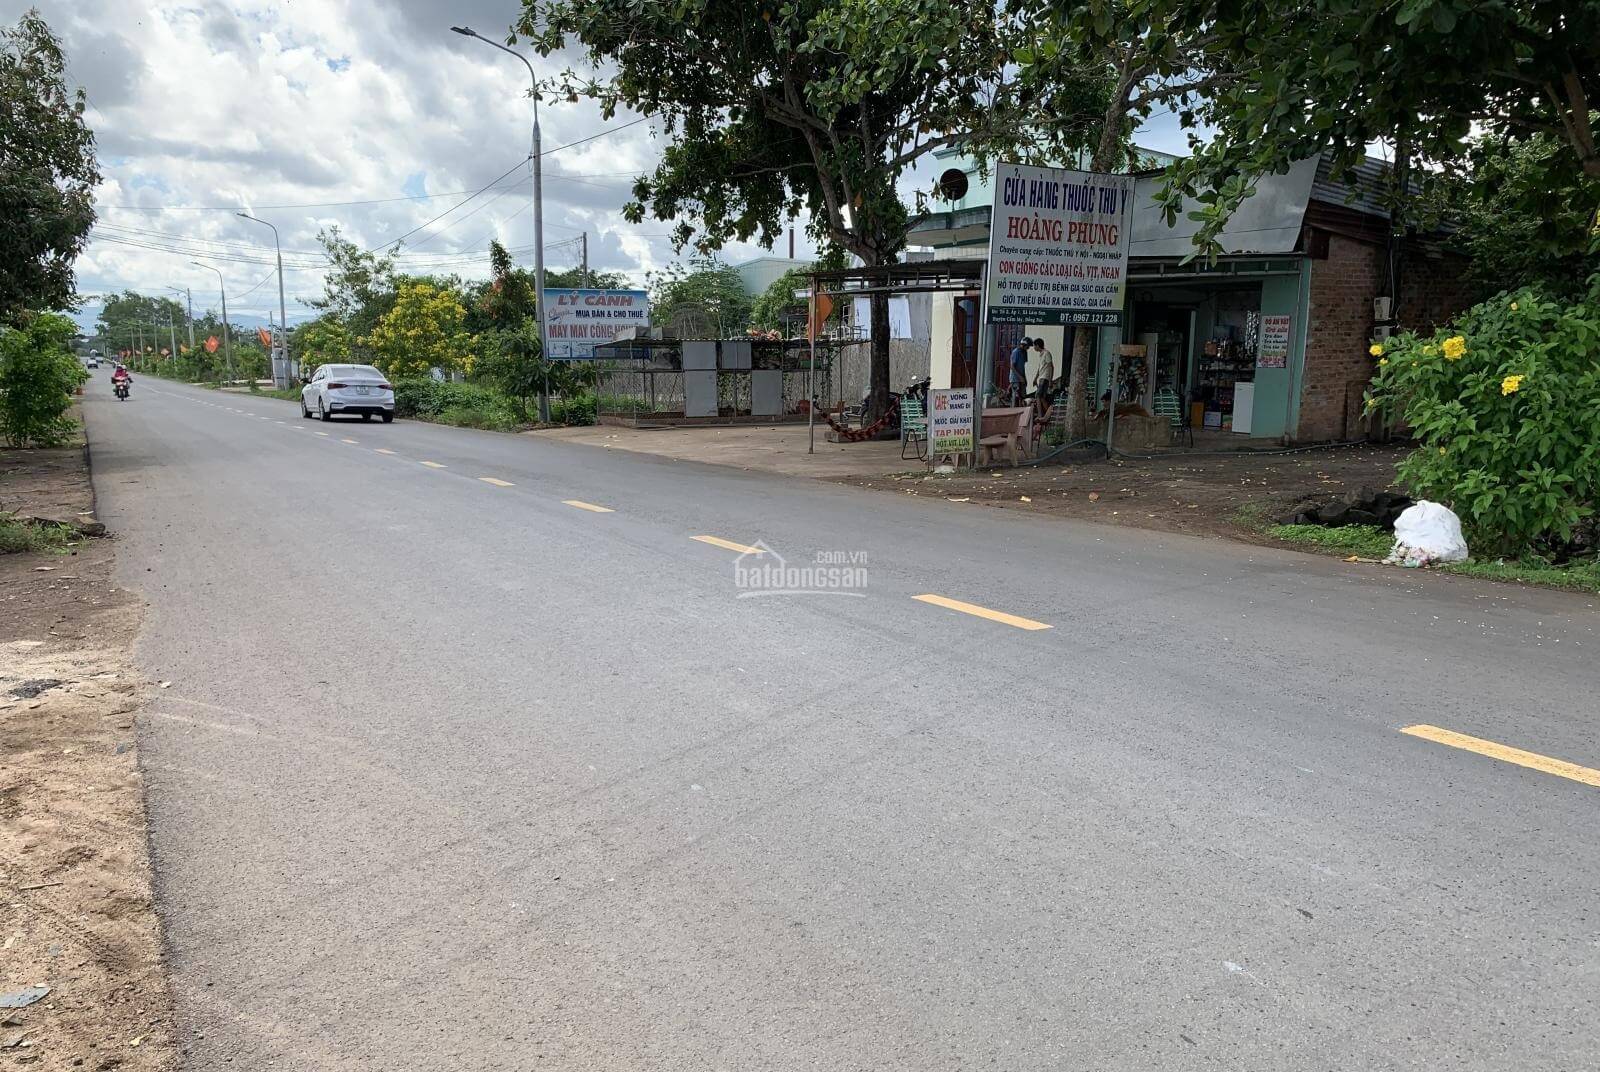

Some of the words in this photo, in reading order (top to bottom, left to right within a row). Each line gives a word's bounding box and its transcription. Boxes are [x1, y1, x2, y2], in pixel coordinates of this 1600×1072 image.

[1004, 168, 1026, 207] CỬA
[1029, 174, 1059, 210] HÀNG
[1062, 177, 1096, 213] THUỐC
[1120, 189, 1128, 215] Y
[1007, 212, 1063, 242] HOÀNG
[1067, 221, 1119, 249] PHỤNG
[999, 245, 1018, 255] Chuyên
[1019, 248, 1032, 256] cung
[1045, 247, 1063, 256] THUỐC
[999, 260, 1015, 274] CON
[1016, 256, 1039, 275] GIỐNG
[1040, 260, 1055, 276] CÁC
[1055, 263, 1073, 279] LOẠI
[1101, 266, 1120, 279] NGAN
[1009, 280, 1022, 291] TRỢ
[1040, 282, 1051, 292] TRỊ
[1070, 284, 1080, 293] GIA
[1081, 283, 1094, 293] SÚC
[1094, 285, 1105, 294] GIA
[585, 291, 634, 306] CẢNH
[1052, 297, 1060, 306] RA
[1061, 298, 1072, 306] GIA
[1088, 298, 1098, 307] GIA
[576, 310, 590, 318] MUA
[1073, 313, 1090, 322] 0967
[1091, 314, 1104, 322] 121
[1105, 314, 1118, 322] 228
[548, 323, 567, 338] MÁY
[569, 324, 588, 338] MAY
